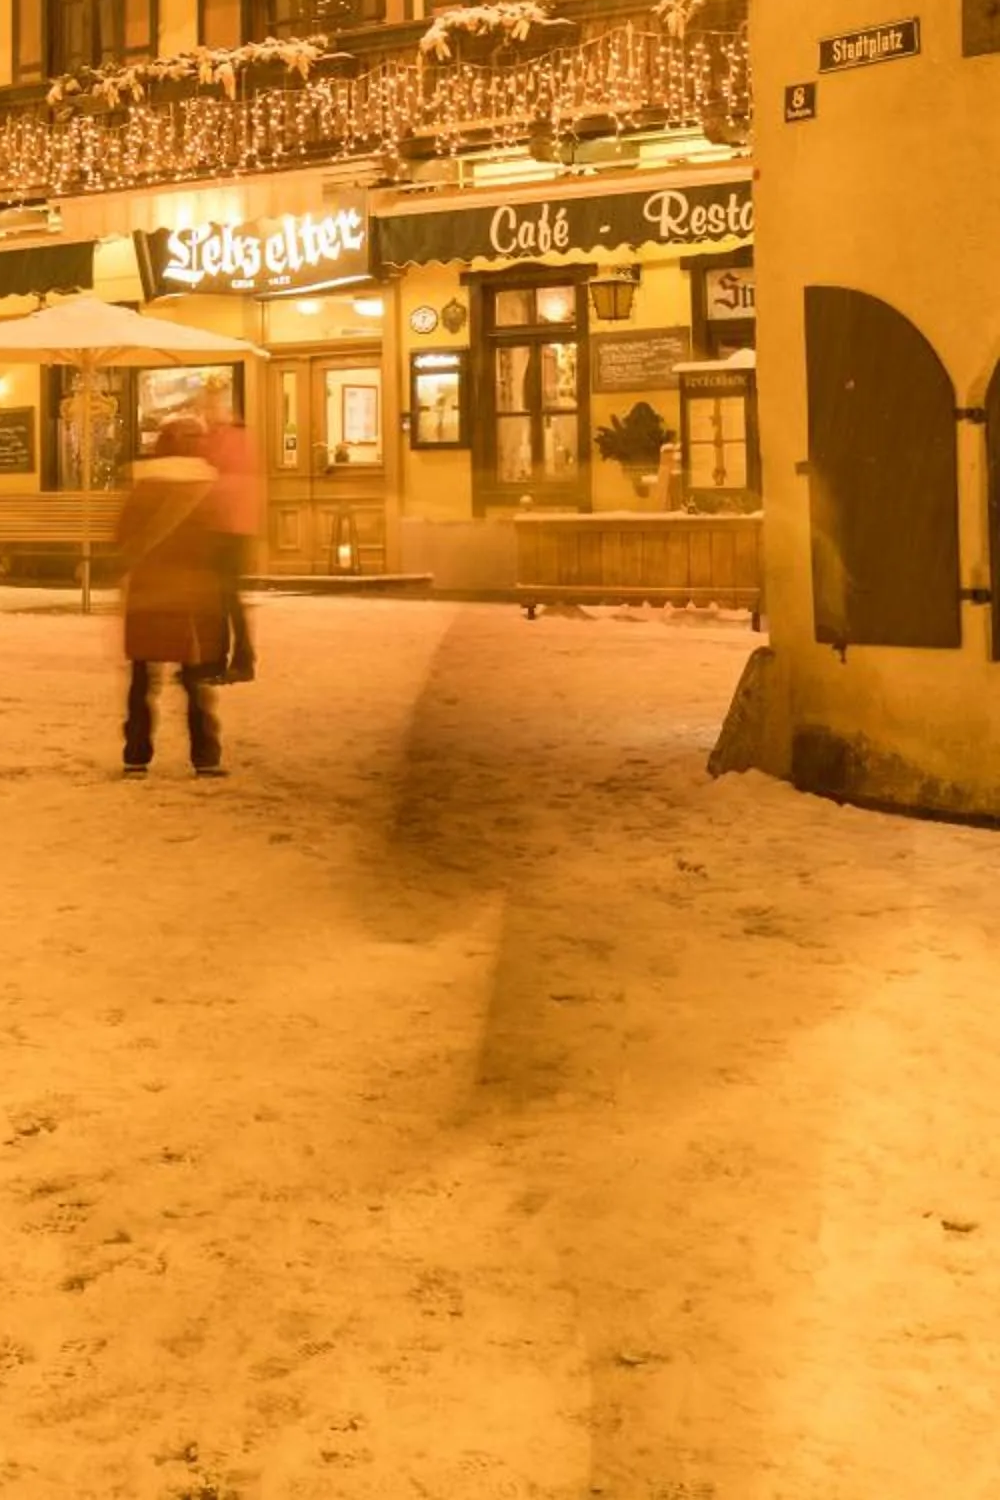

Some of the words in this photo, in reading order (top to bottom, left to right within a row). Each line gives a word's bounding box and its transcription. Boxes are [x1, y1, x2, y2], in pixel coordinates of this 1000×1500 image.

[832, 29, 903, 63] Stadtplatz
[792, 87, 805, 108] 8
[162, 208, 365, 284] Lebzelter
[489, 203, 569, 254] Café
